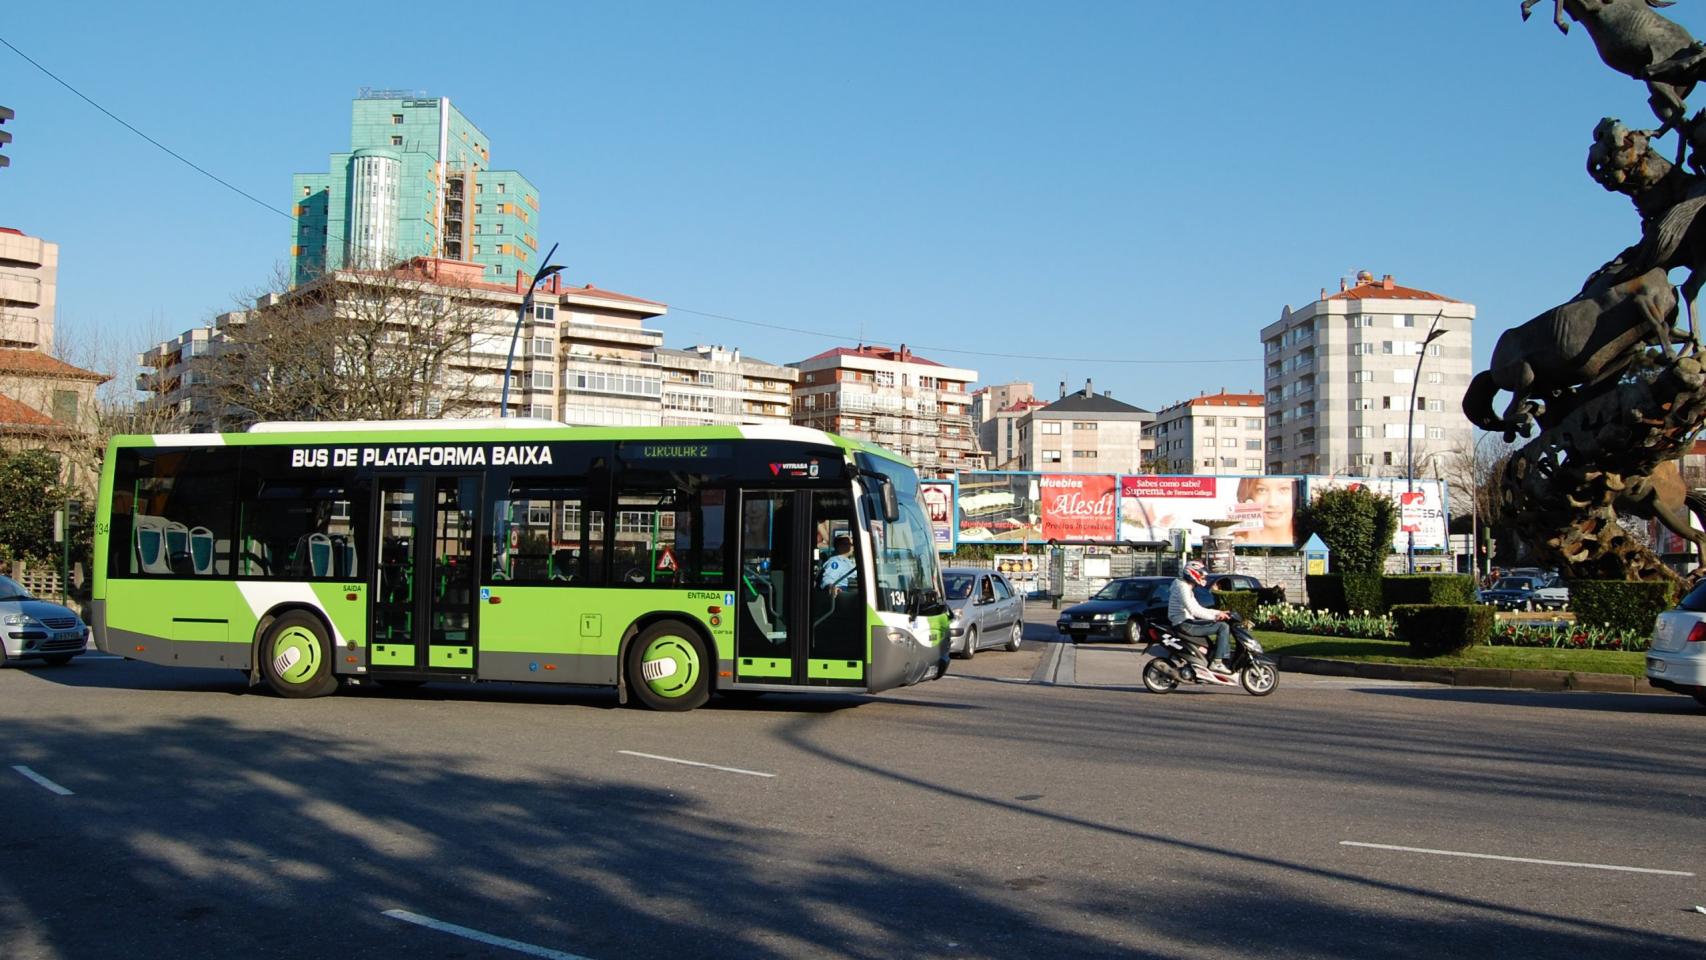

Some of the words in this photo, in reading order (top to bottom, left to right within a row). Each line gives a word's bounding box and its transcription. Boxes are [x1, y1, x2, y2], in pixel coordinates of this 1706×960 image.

[291, 449, 329, 467] BUS
[333, 449, 358, 467] DE
[362, 447, 487, 467] PLATAFORMA
[491, 446, 553, 465] BAIXA
[644, 446, 698, 457] CIRCULAR
[700, 446, 708, 457] 2
[1040, 477, 1083, 488] Muebles
[1136, 480, 1158, 488] Sabes
[1181, 480, 1202, 488] sabe?
[1125, 487, 1165, 496] Suprema,
[687, 592, 720, 600] ENTRADA
[891, 591, 906, 606] 134
